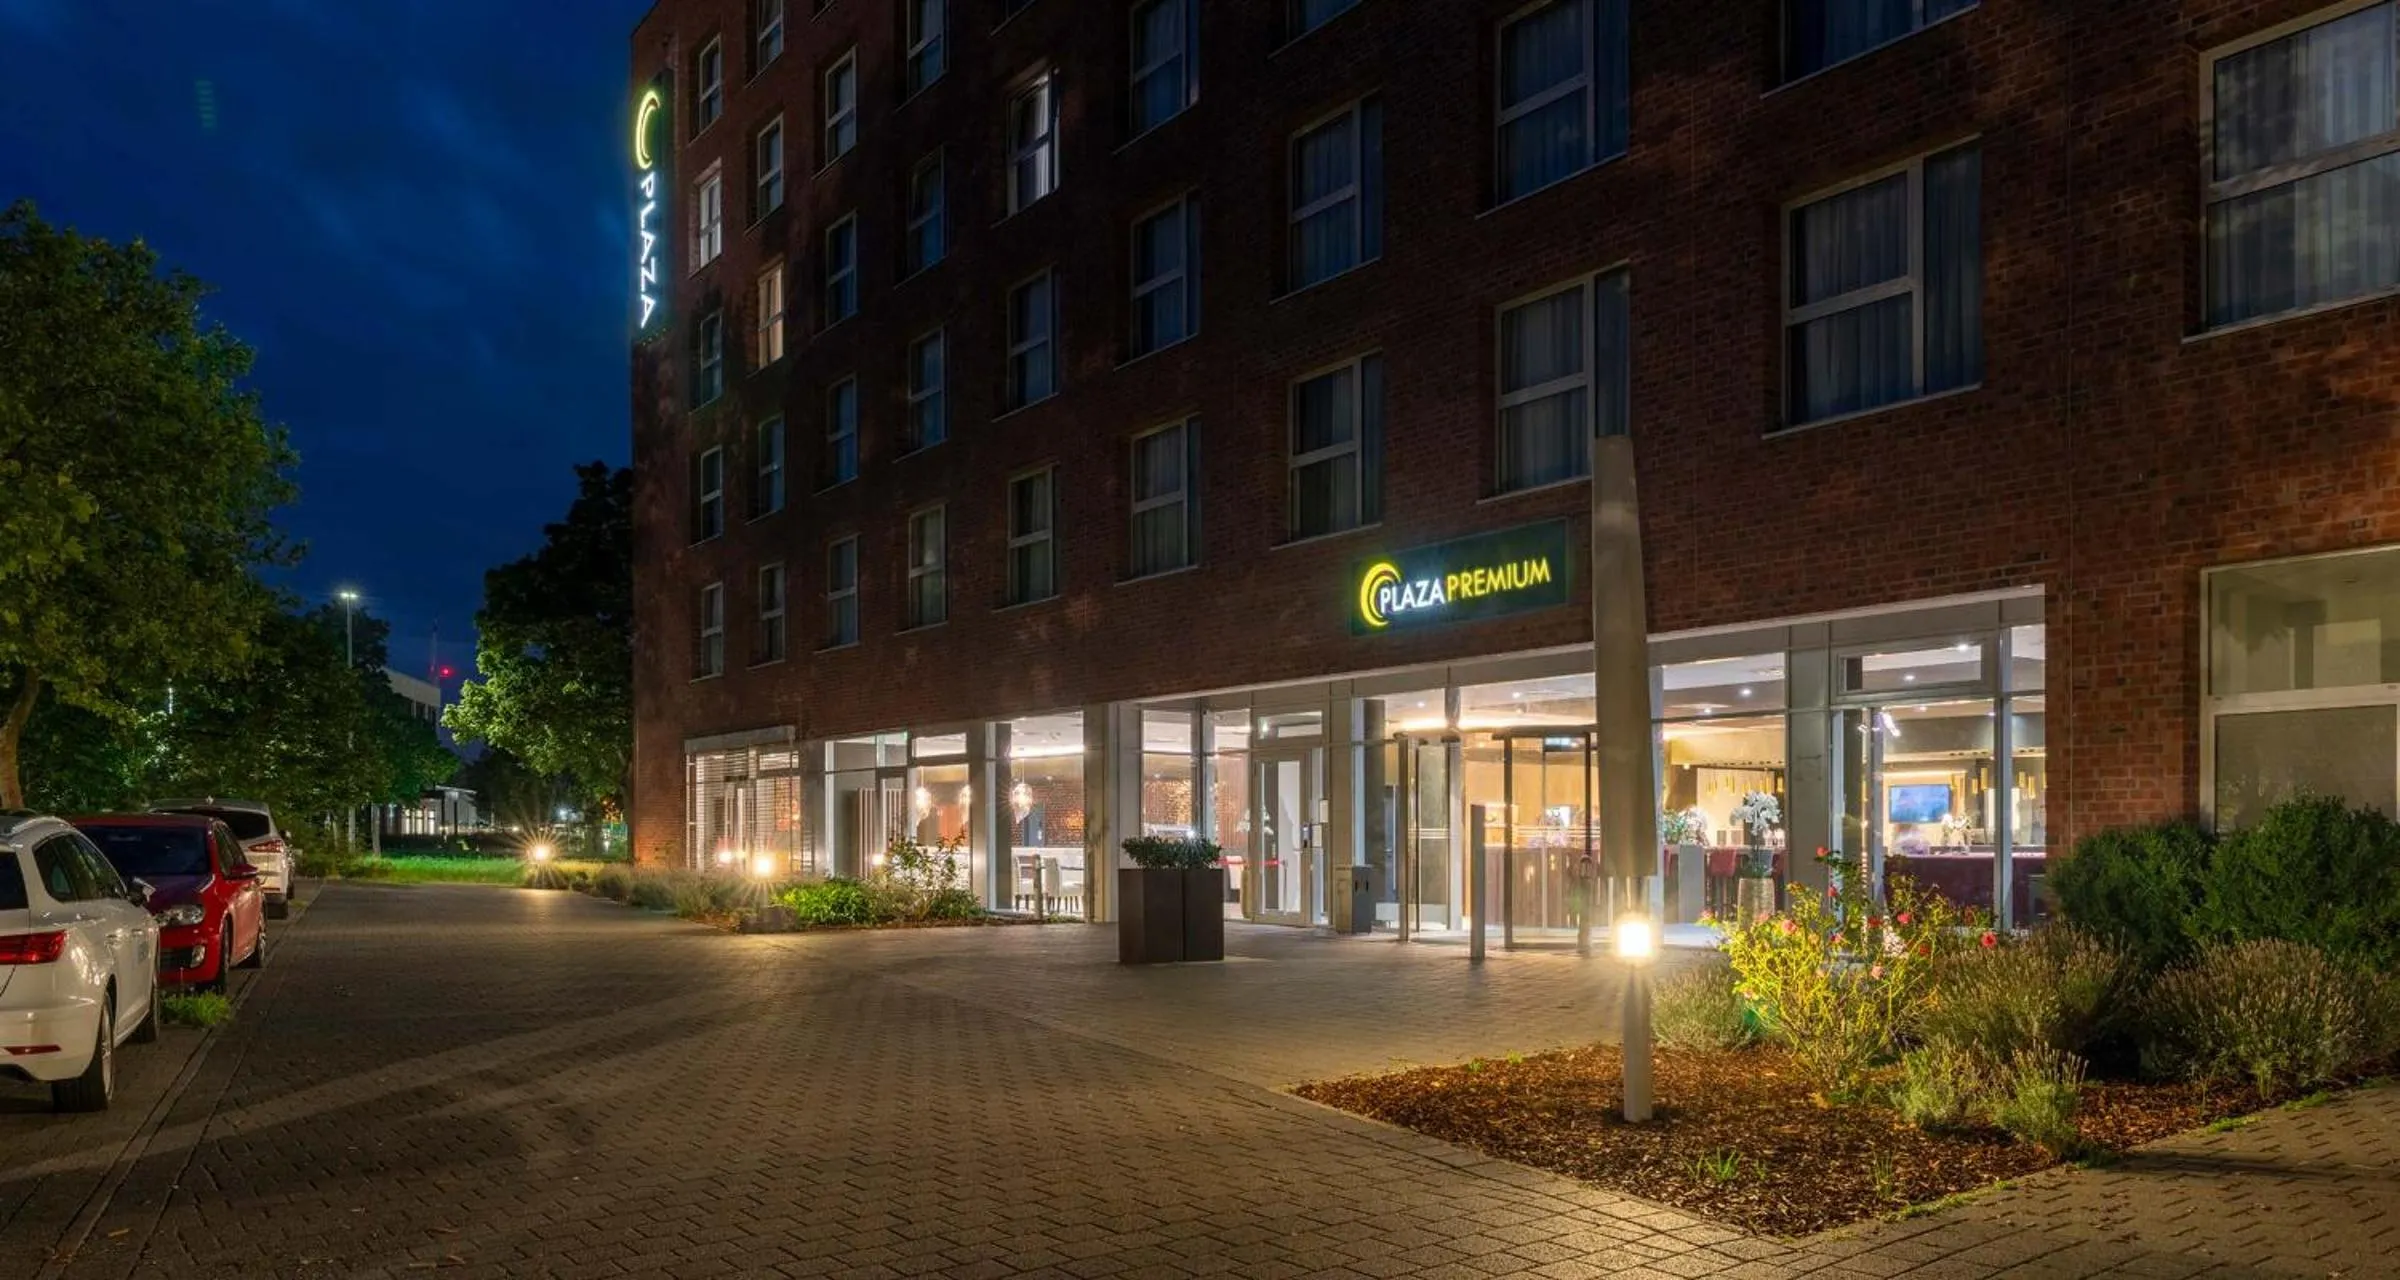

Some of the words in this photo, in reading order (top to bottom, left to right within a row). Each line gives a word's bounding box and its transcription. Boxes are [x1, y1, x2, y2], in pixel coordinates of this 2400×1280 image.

[640, 171, 656, 329] PLAZA
[1380, 578, 1445, 614] PLAZA
[1447, 557, 1551, 602] PREMIUM
